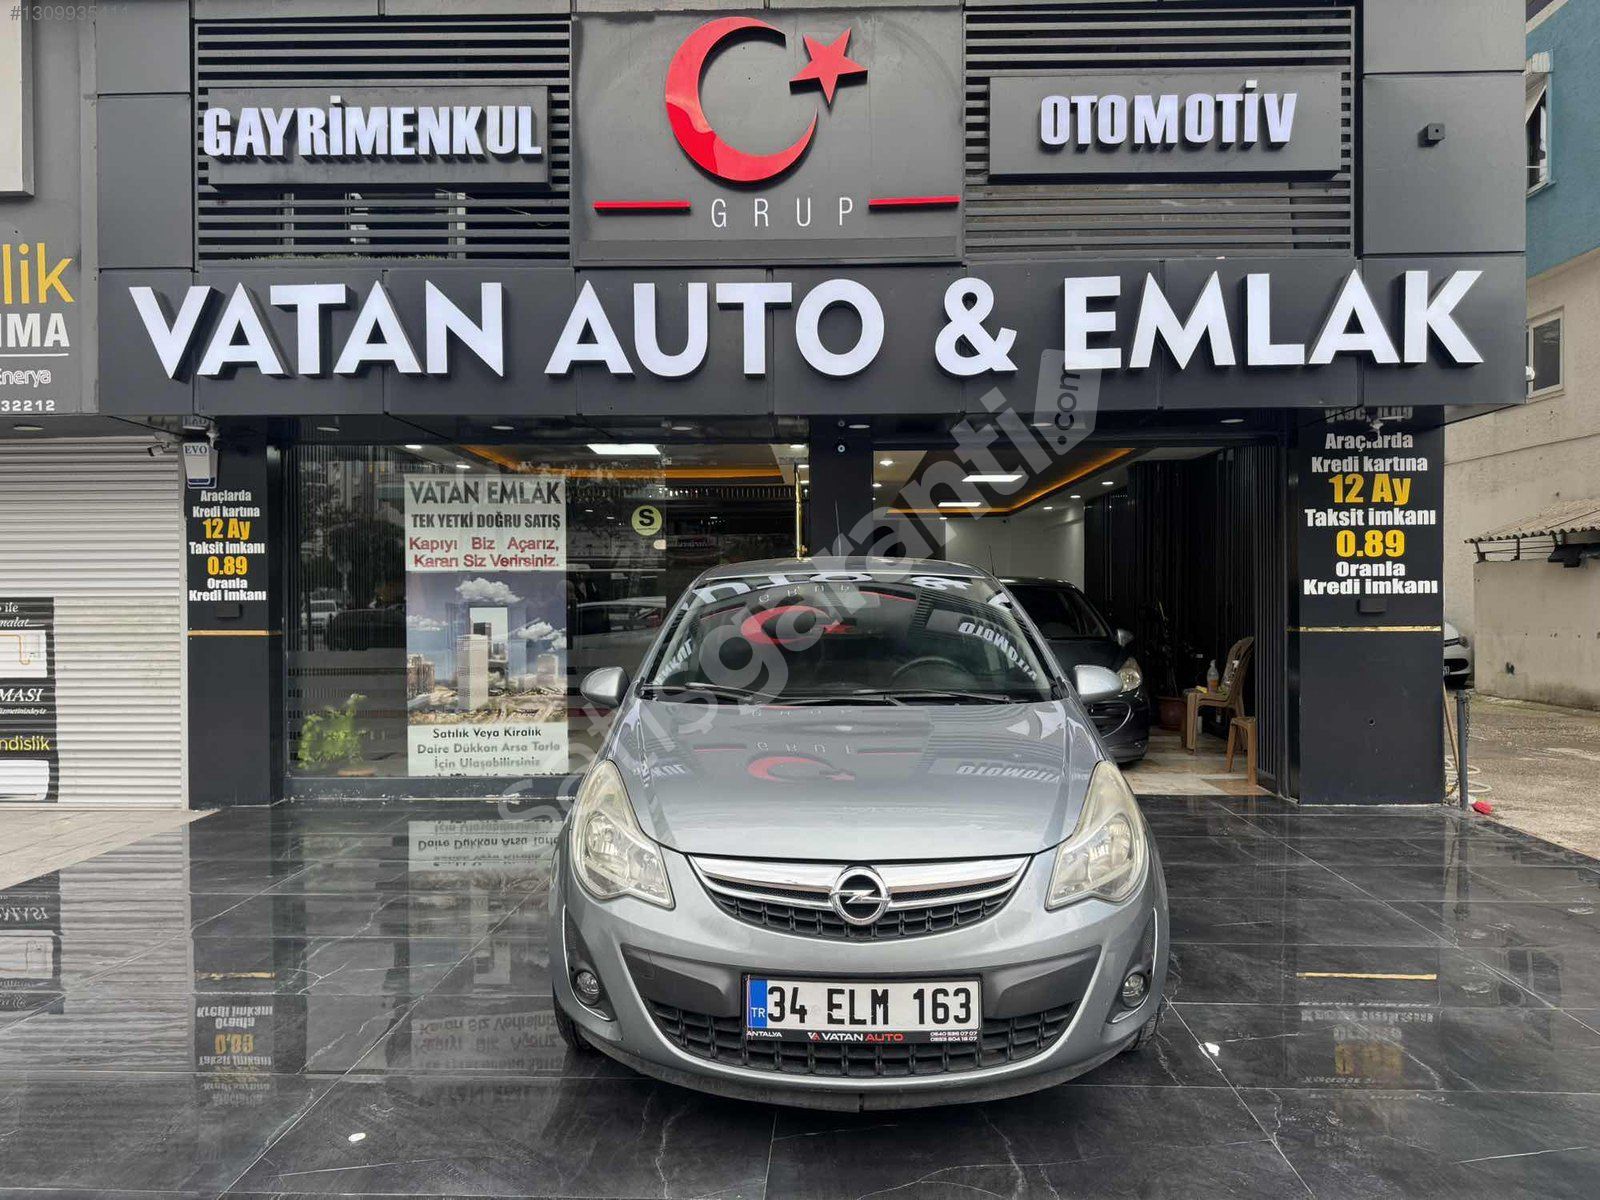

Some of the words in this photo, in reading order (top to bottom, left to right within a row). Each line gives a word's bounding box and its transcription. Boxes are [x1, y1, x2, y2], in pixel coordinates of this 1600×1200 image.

[1040, 80, 1297, 146] OTOMOTİV
[203, 95, 542, 157] GAYRİMENKUL
[711, 198, 853, 228] GRUP
[0, 313, 70, 347] MA
[129, 280, 503, 379] VATAN
[544, 278, 884, 377] AUTO
[935, 277, 1018, 377] &
[1064, 269, 1484, 371] EMLAK
[1, 400, 56, 412] 32212
[1311, 456, 1359, 473] Kredi
[1363, 456, 1428, 472] kartına
[200, 489, 252, 505] Araçlarda
[408, 481, 480, 504] VATAN
[487, 481, 562, 504] EMLAK
[1328, 473, 1364, 504] 12
[1371, 473, 1412, 506] Ay
[192, 505, 221, 518] Kredi
[222, 506, 260, 518] kartına
[639, 509, 655, 526] S
[1304, 508, 1365, 527] Taksit
[1368, 507, 1436, 525] imkanı
[203, 518, 223, 539] 12
[227, 518, 251, 540] Ay
[411, 514, 435, 528] TEK
[437, 511, 473, 528] YETKİ
[477, 511, 521, 531] DOĞRU
[525, 514, 561, 531] SATIŞ
[189, 541, 224, 555] Taksit
[409, 537, 458, 555] Kapıyı
[472, 537, 495, 550] Biz
[507, 537, 559, 553] Açarız,
[1336, 529, 1405, 557] 0.89
[207, 556, 248, 576] 0.89
[463, 554, 486, 567] Siz
[1335, 561, 1406, 577] Oranla
[207, 577, 248, 589] Oranla
[1303, 579, 1361, 595] Kredi
[1365, 579, 1438, 595] imkanı
[189, 589, 222, 602] Kredi
[433, 728, 469, 739] Satılık
[473, 729, 499, 740] Veya
[417, 744, 449, 754] Daire
[453, 742, 498, 753] Dükkan
[501, 743, 528, 752] Arsa
[532, 741, 560, 751] Tarla
[434, 756, 455, 771] İçin
[751, 1007, 765, 1018] TR
[767, 986, 807, 1023] 34
[827, 988, 889, 1025] ELM
[913, 988, 971, 1025] 163
[821, 1032, 864, 1042] VATAN
[865, 1033, 905, 1042] AUTO
